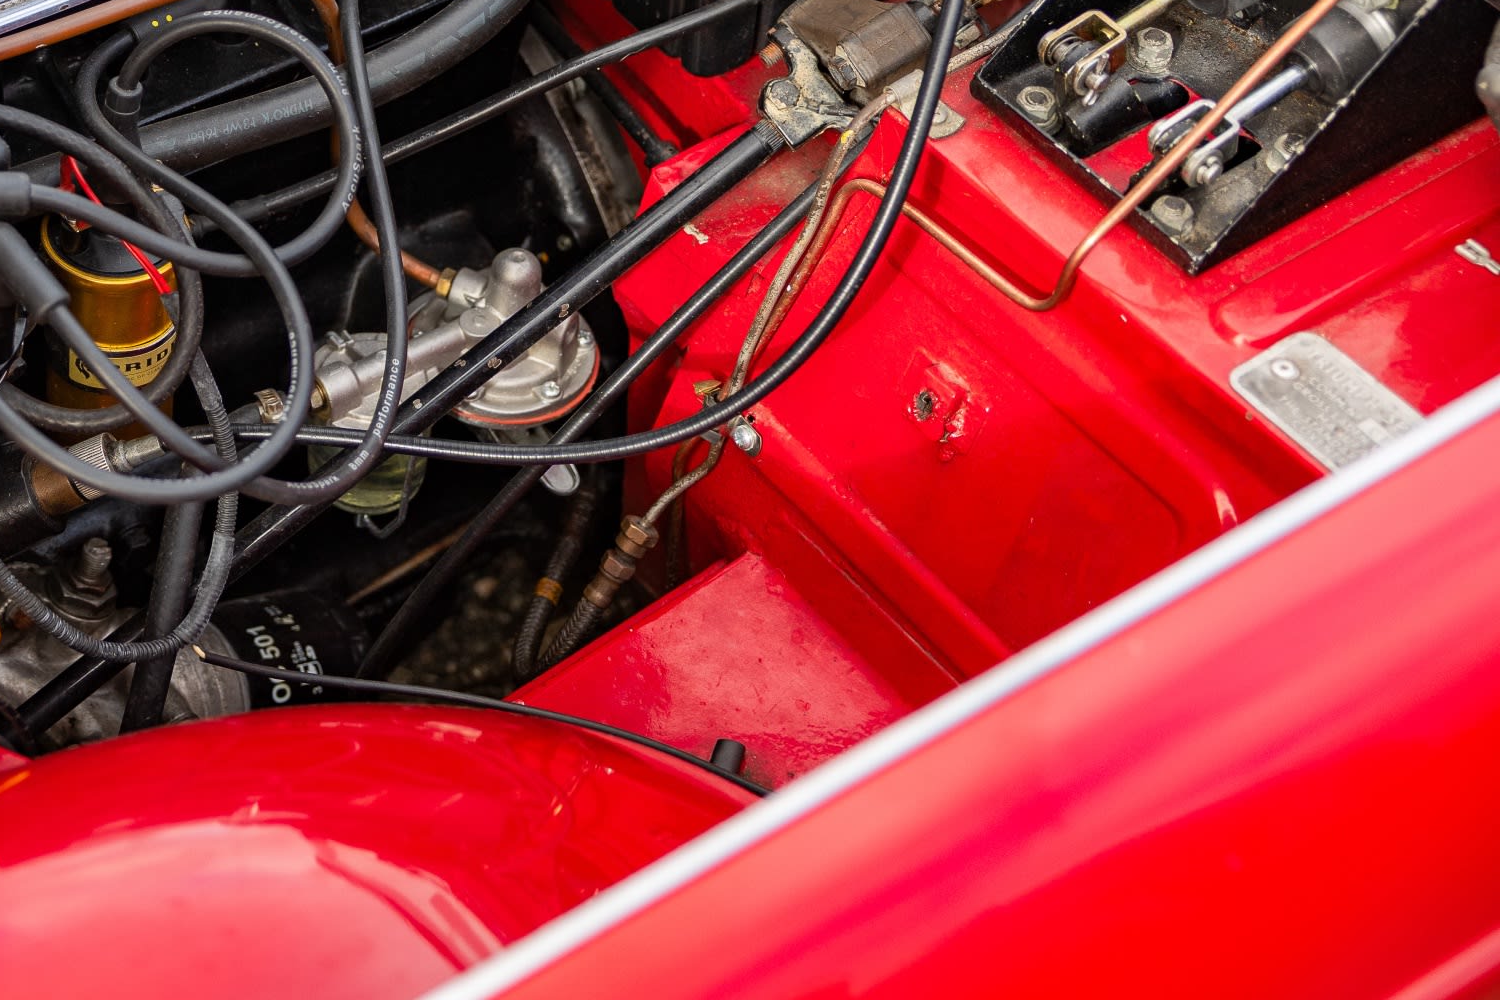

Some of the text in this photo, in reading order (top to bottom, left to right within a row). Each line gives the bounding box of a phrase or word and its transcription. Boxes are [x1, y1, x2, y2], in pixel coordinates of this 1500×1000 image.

[202, 9, 310, 44] performance
[341, 124, 362, 212] AccuSpark
[115, 344, 175, 372] RID
[349, 448, 371, 471] 8mm
[373, 357, 401, 437] performance
[245, 624, 280, 659] 501
